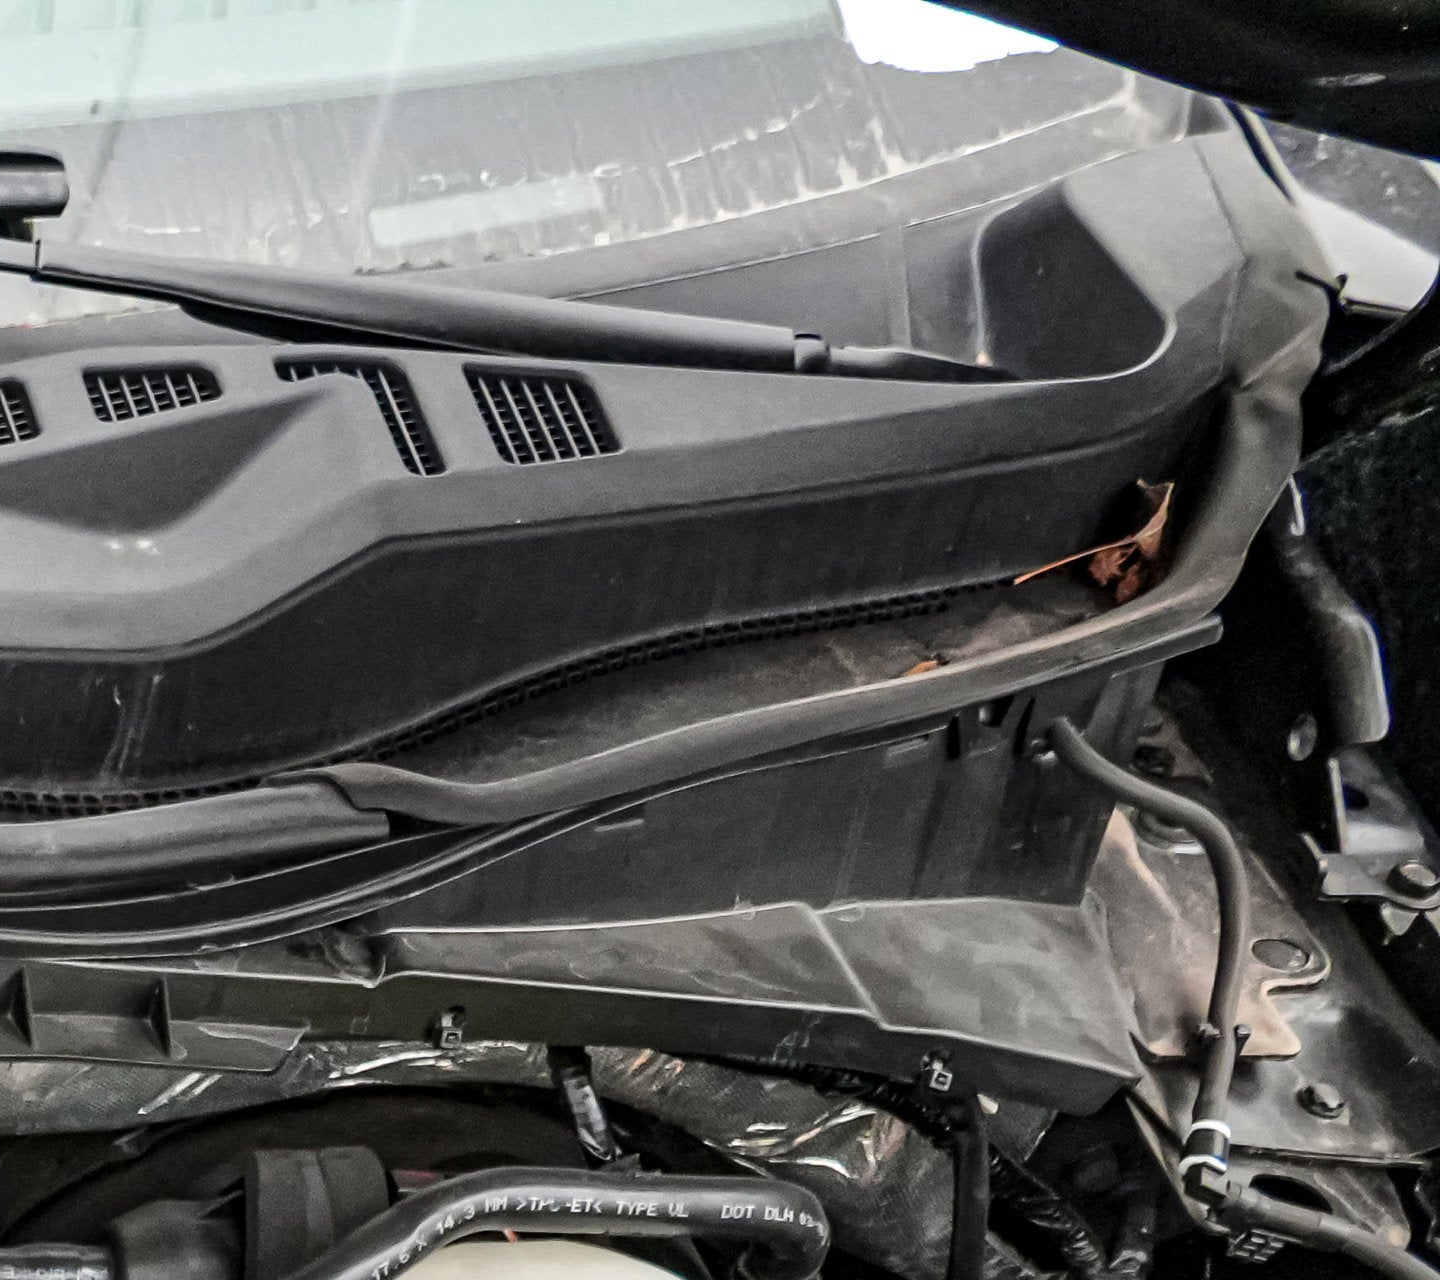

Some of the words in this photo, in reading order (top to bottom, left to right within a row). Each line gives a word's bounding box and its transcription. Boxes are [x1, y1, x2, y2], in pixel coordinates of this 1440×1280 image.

[435, 1205, 477, 1234] 14.3
[615, 1201, 658, 1217] TYPE
[668, 1203, 690, 1217] UL
[721, 1204, 757, 1220] DOT
